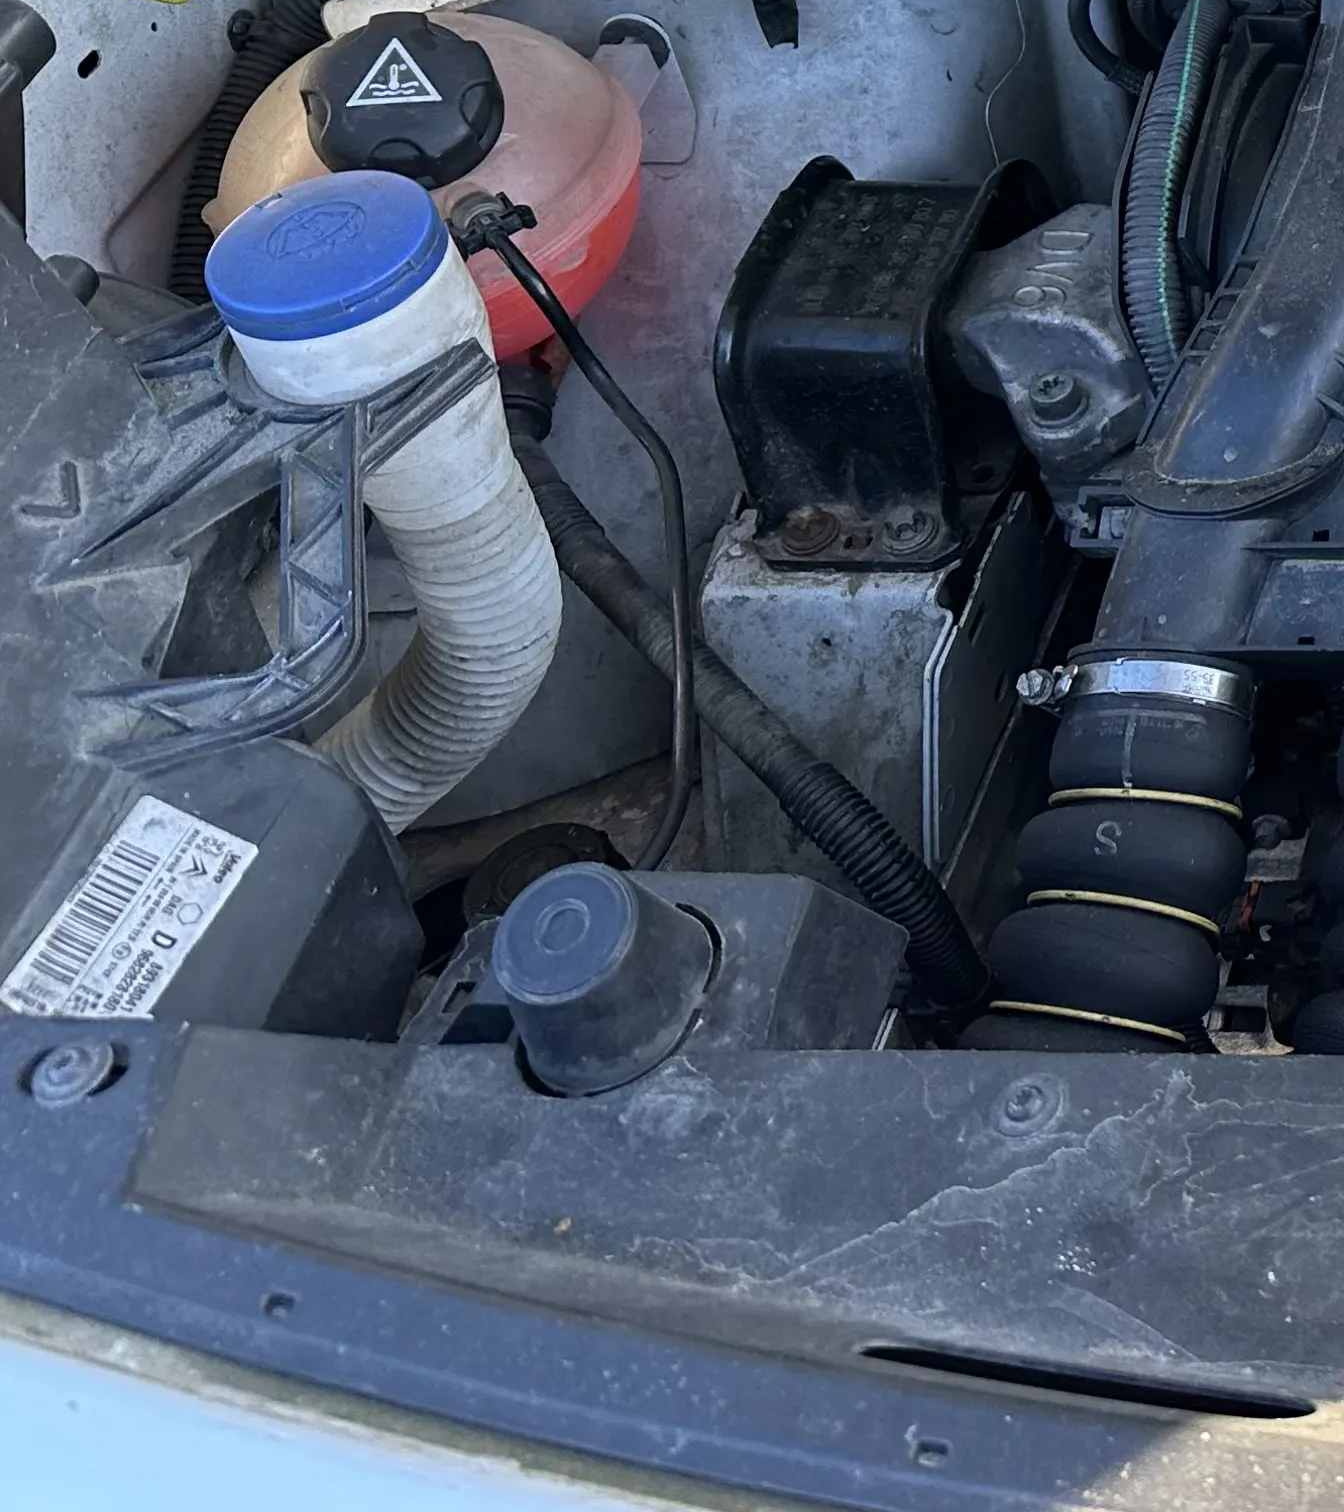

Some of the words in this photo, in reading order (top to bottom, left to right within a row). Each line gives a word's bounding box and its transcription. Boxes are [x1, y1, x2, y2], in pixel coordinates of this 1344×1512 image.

[1013, 229, 1095, 308] DV6
[213, 851, 242, 884] Valeo
[151, 930, 178, 951] D
